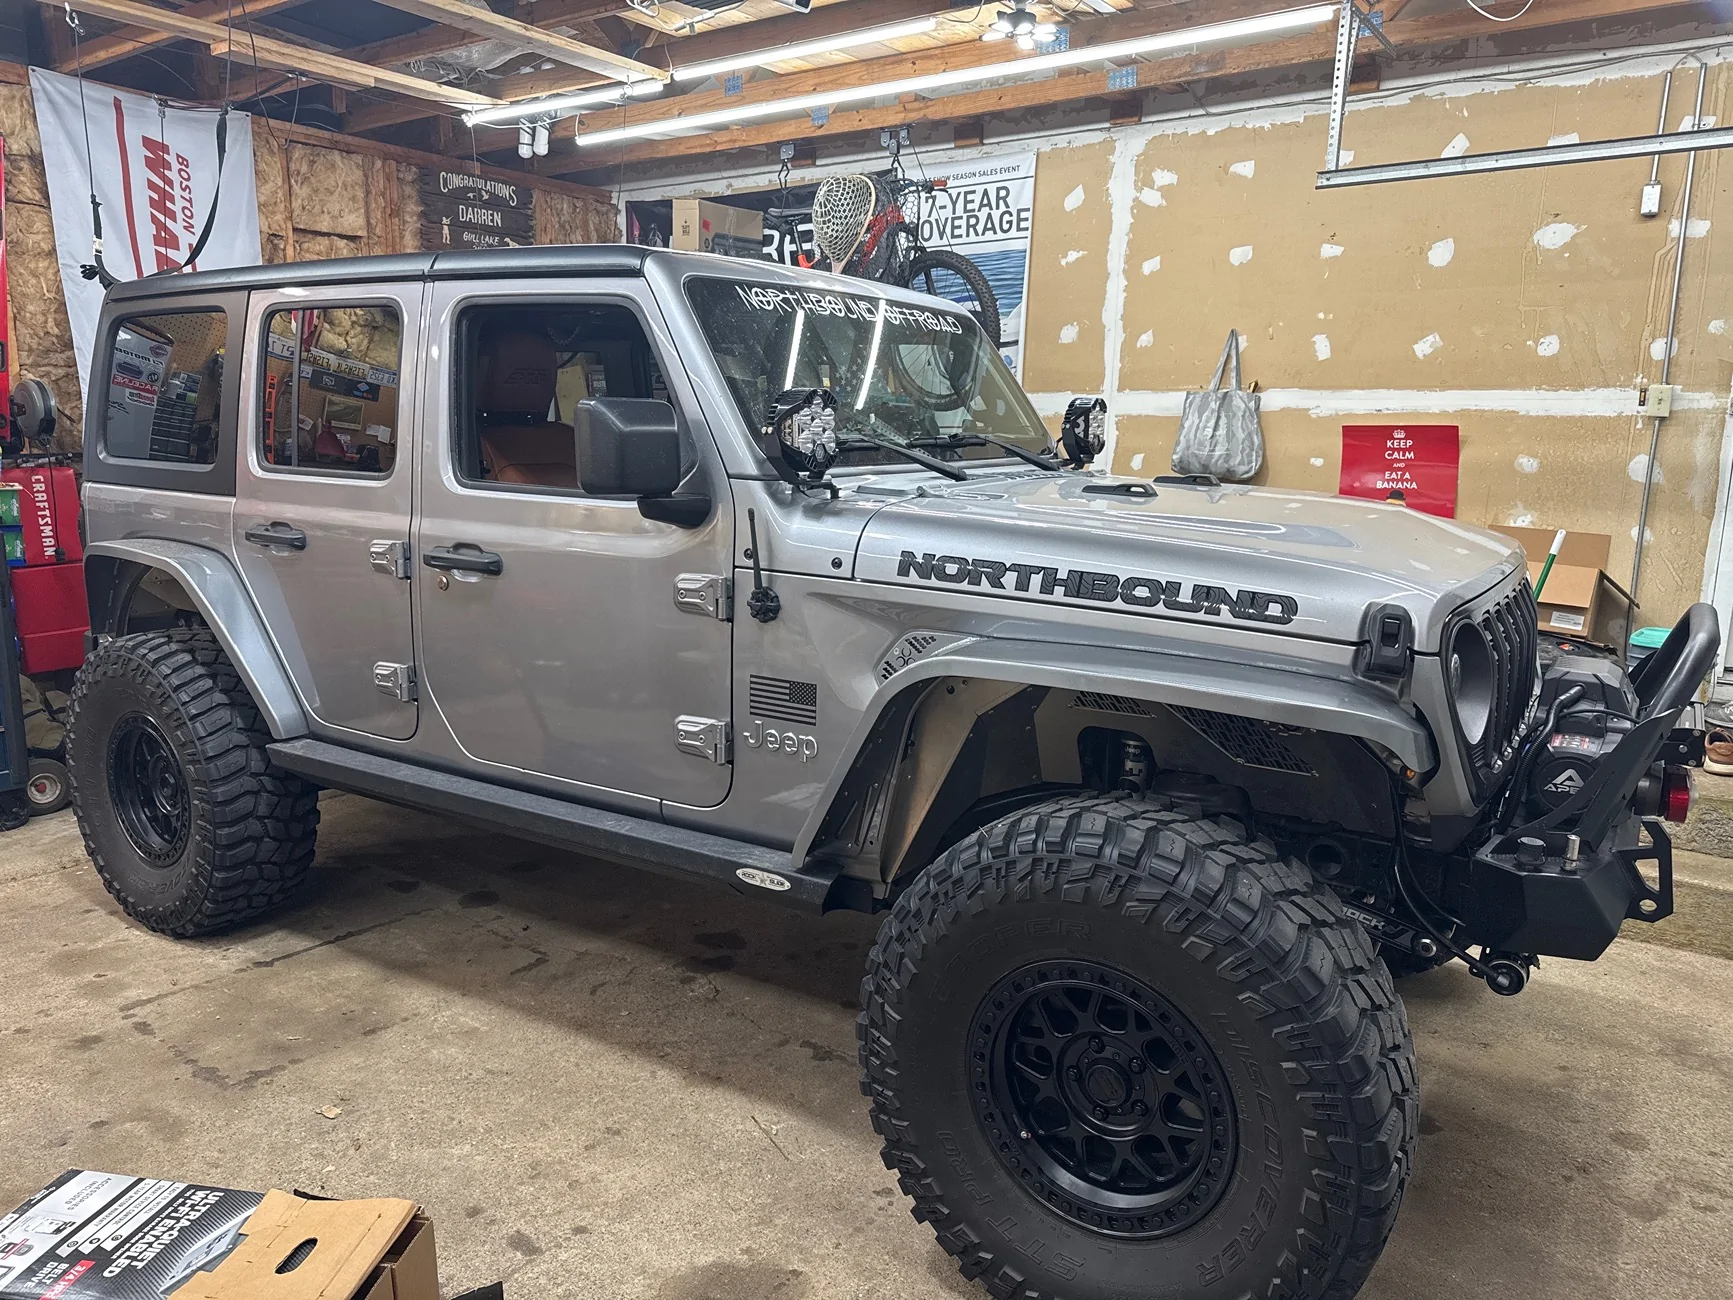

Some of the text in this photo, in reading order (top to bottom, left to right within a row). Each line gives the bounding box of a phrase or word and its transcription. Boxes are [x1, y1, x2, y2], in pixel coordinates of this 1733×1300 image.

[952, 171, 977, 181] SEASON
[978, 167, 998, 177] SALES
[999, 165, 1021, 175] EVENT
[175, 152, 196, 236] BOSTON
[440, 171, 517, 206] CONGRATULATIONS
[924, 185, 1011, 219] 7-YEAR
[459, 205, 502, 227] DARREN
[920, 207, 1031, 242] OVERAGE
[463, 231, 499, 246] GULL LAKE
[735, 285, 963, 335] NORTHBOUND OFFROAD
[1385, 451, 1414, 459] CALM
[1386, 440, 1413, 448] KEEP
[1376, 481, 1417, 489] BANANA
[1384, 471, 1411, 479] EAT A
[31, 475, 56, 557] CRAFTSMAN
[896, 550, 1299, 625] NORTHBOUND
[743, 720, 818, 763] Jeep
[1543, 783, 1581, 795] APE
[1198, 1012, 1284, 1288] DISCOVERER
[63, 1180, 99, 1204] INCLUDED
[66, 1177, 112, 1210] ACCESSORIES
[129, 1191, 224, 1268] ULTRA-QUIET
[101, 1219, 177, 1276] ENABLED
[22, 1261, 59, 1288] DRIVE
[40, 1263, 70, 1284] BELT
[63, 1265, 87, 1280] 3/4
